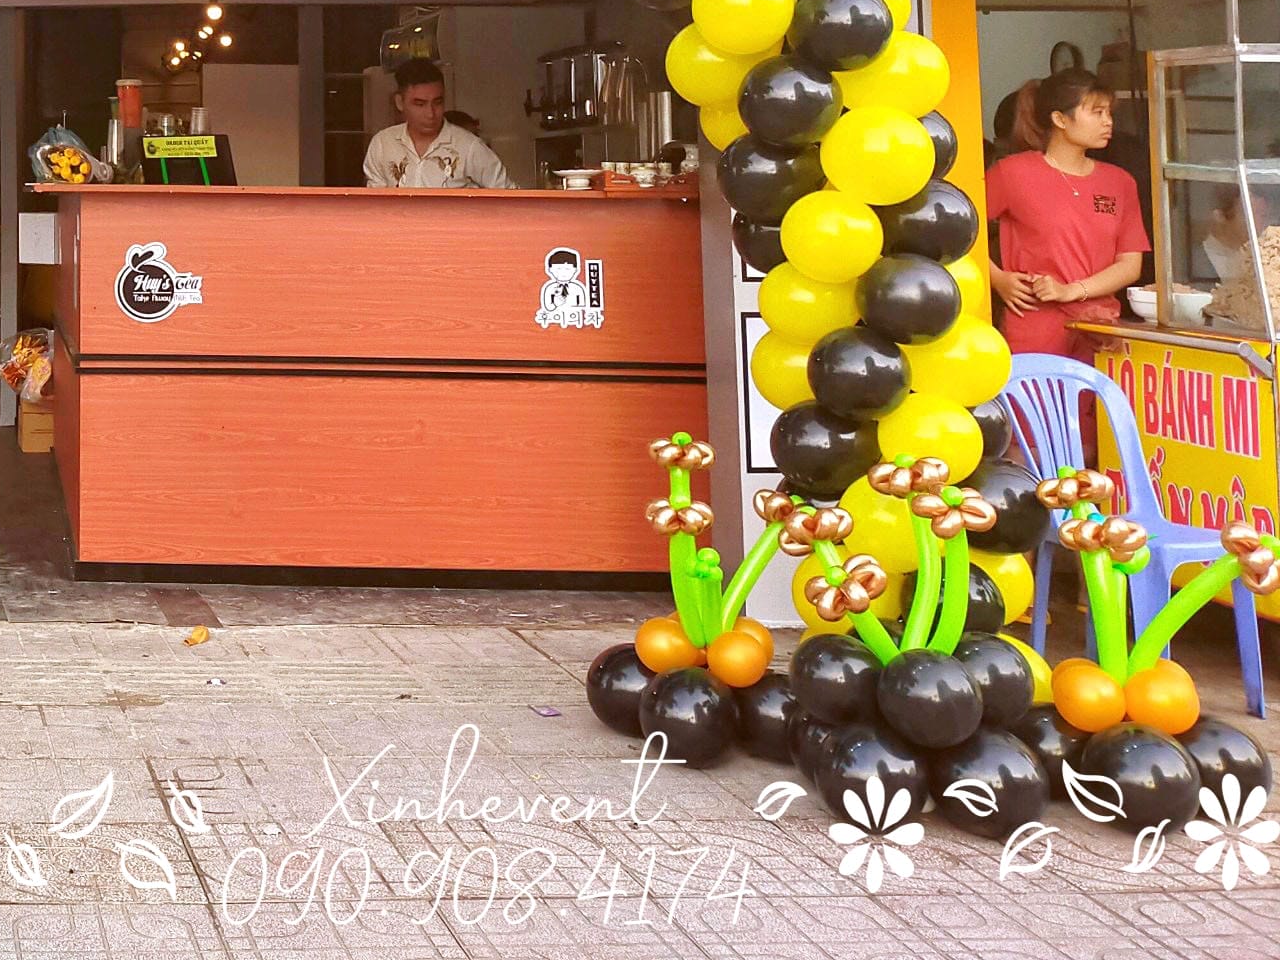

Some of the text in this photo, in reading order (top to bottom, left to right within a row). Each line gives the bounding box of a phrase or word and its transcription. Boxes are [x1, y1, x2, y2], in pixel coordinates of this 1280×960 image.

[134, 273, 199, 294] Huy's Tea
[133, 294, 150, 303] Take
[151, 294, 171, 303] Away
[1143, 351, 1217, 449] BÁNH
[1223, 364, 1261, 459] MÌ
